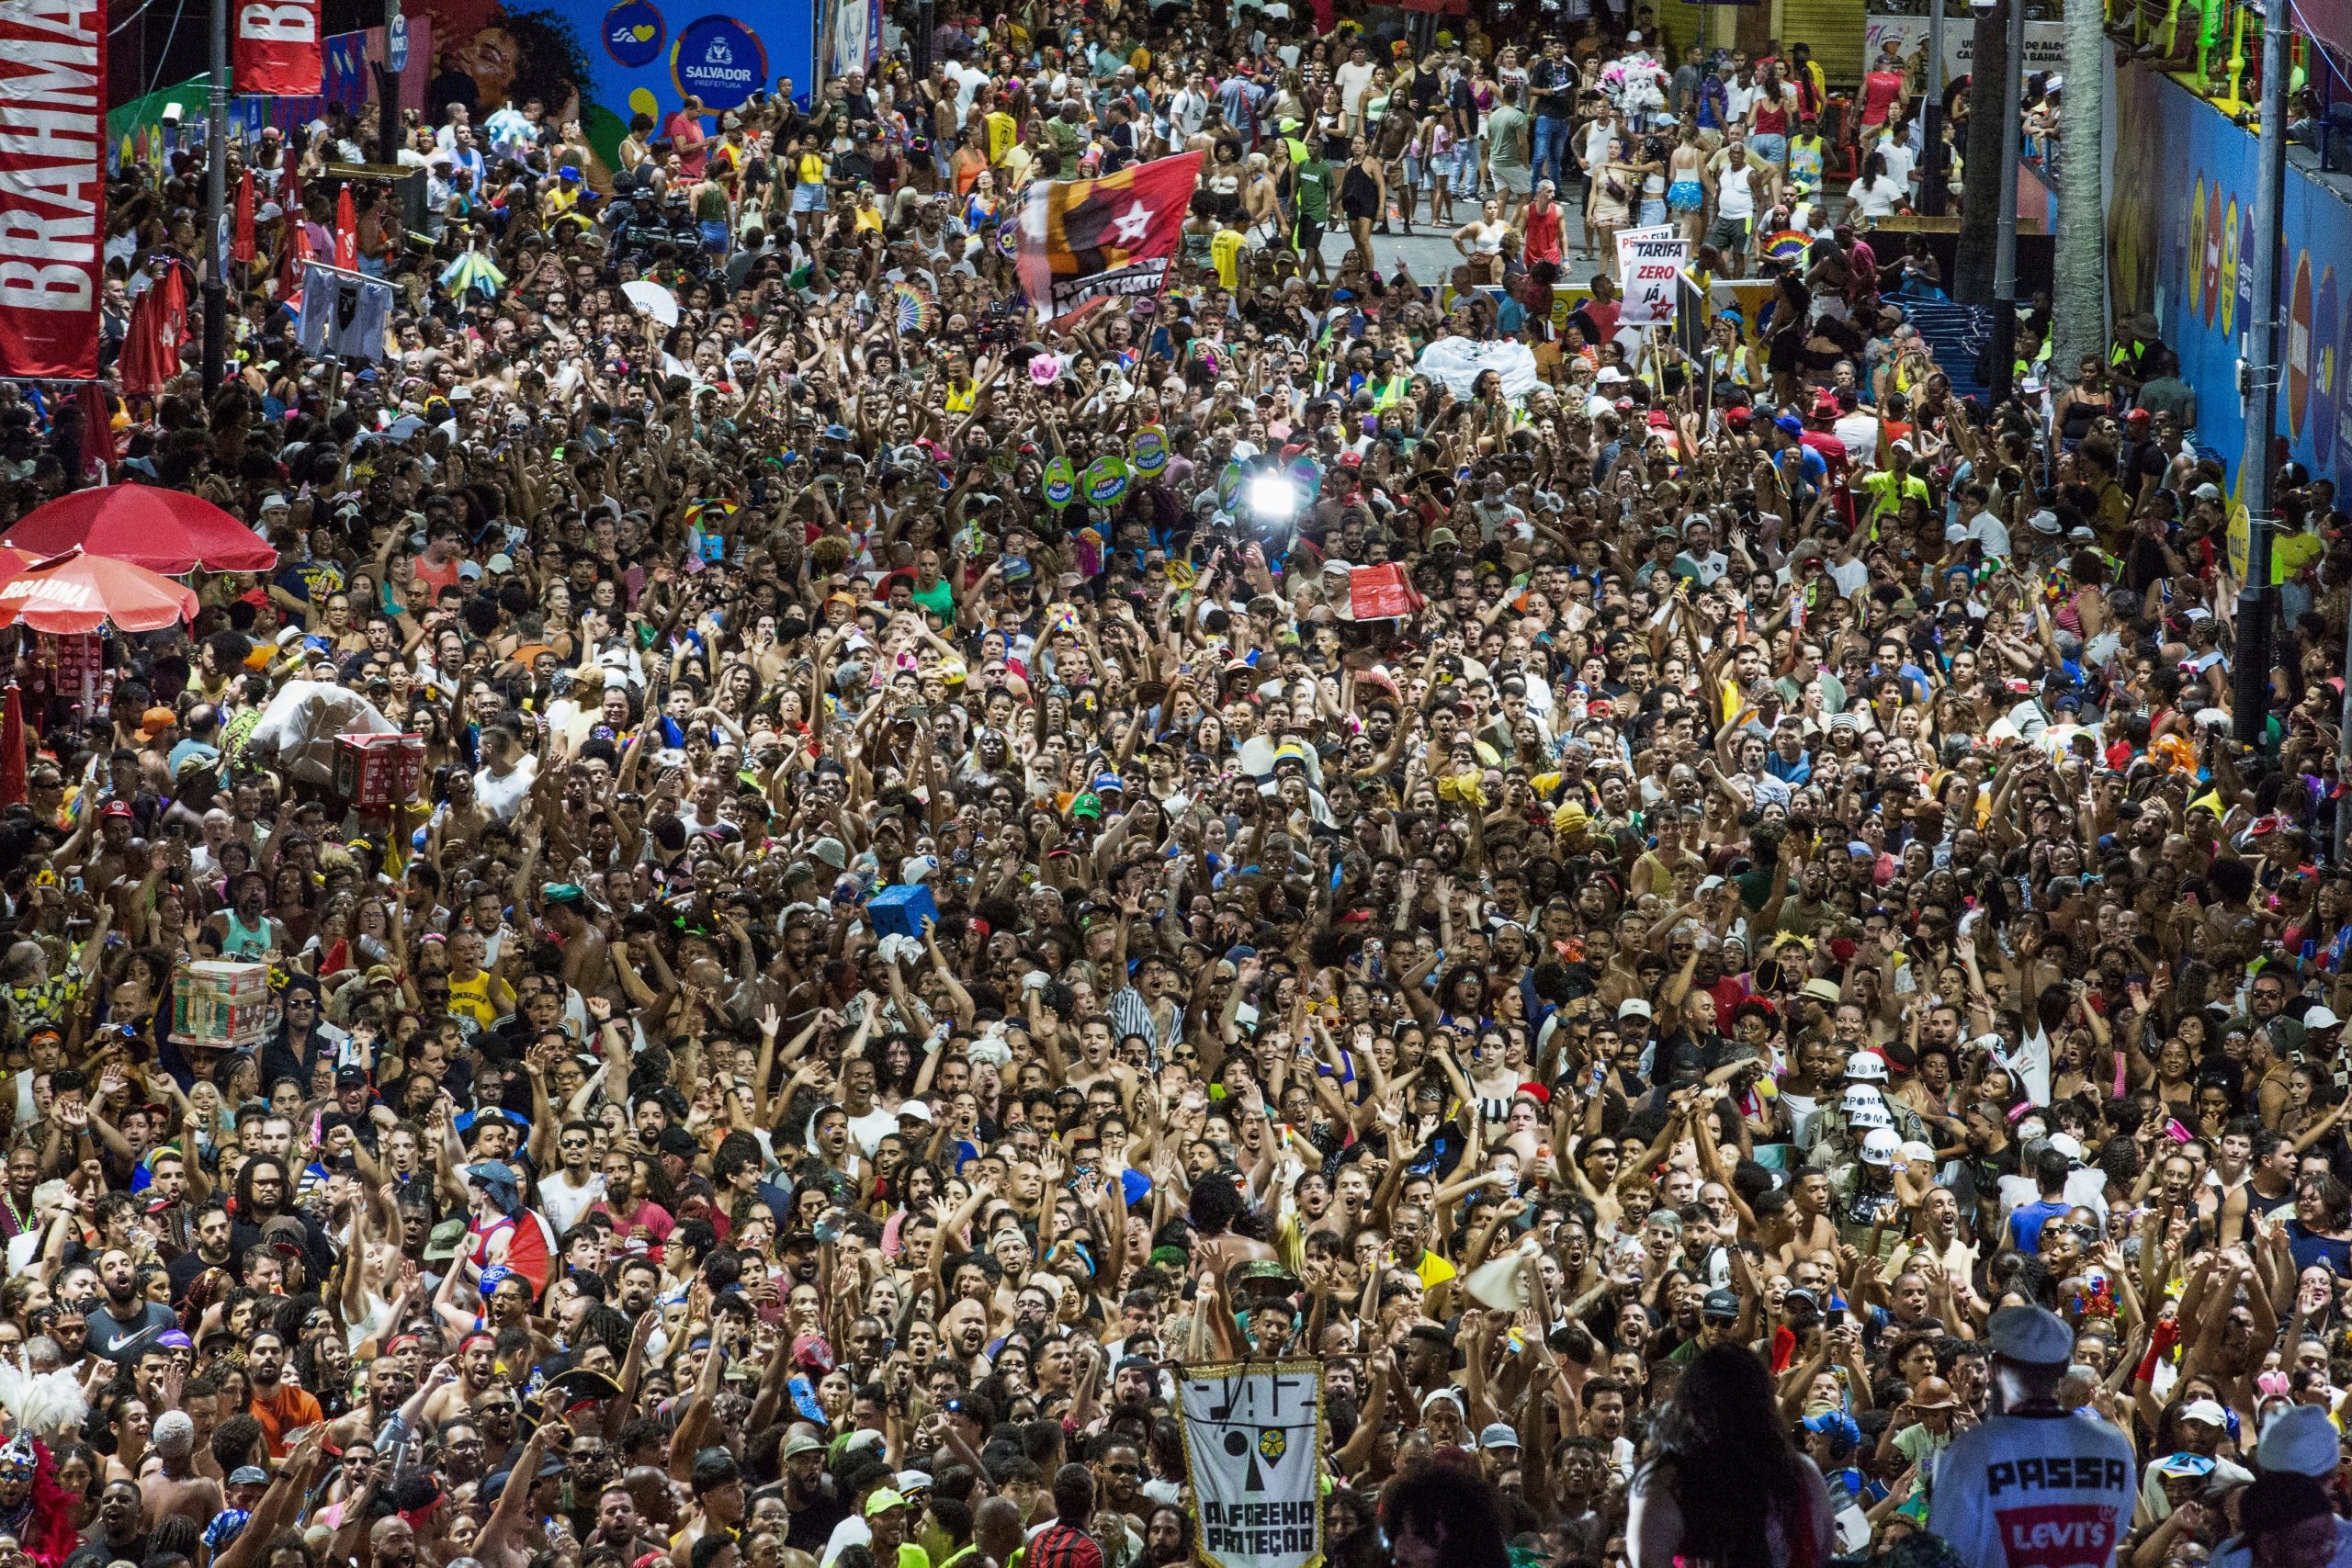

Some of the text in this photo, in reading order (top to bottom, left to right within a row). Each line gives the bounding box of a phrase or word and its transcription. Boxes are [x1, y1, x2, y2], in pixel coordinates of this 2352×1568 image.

[684, 65, 752, 82] SALVADOR
[695, 79, 741, 89] PREFEITURA
[0, 0, 97, 311] BRAHMA
[1637, 243, 1682, 257] TARIFA
[1636, 265, 1675, 279] ZERO
[1643, 283, 1660, 303] JÁ
[1136, 452, 1165, 468] RACISMO
[1047, 486, 1071, 500] RACISMO
[1092, 478, 1125, 499] RACISMO
[0, 579, 92, 608] BRAHMA
[1987, 1456, 2127, 1496] PASSA
